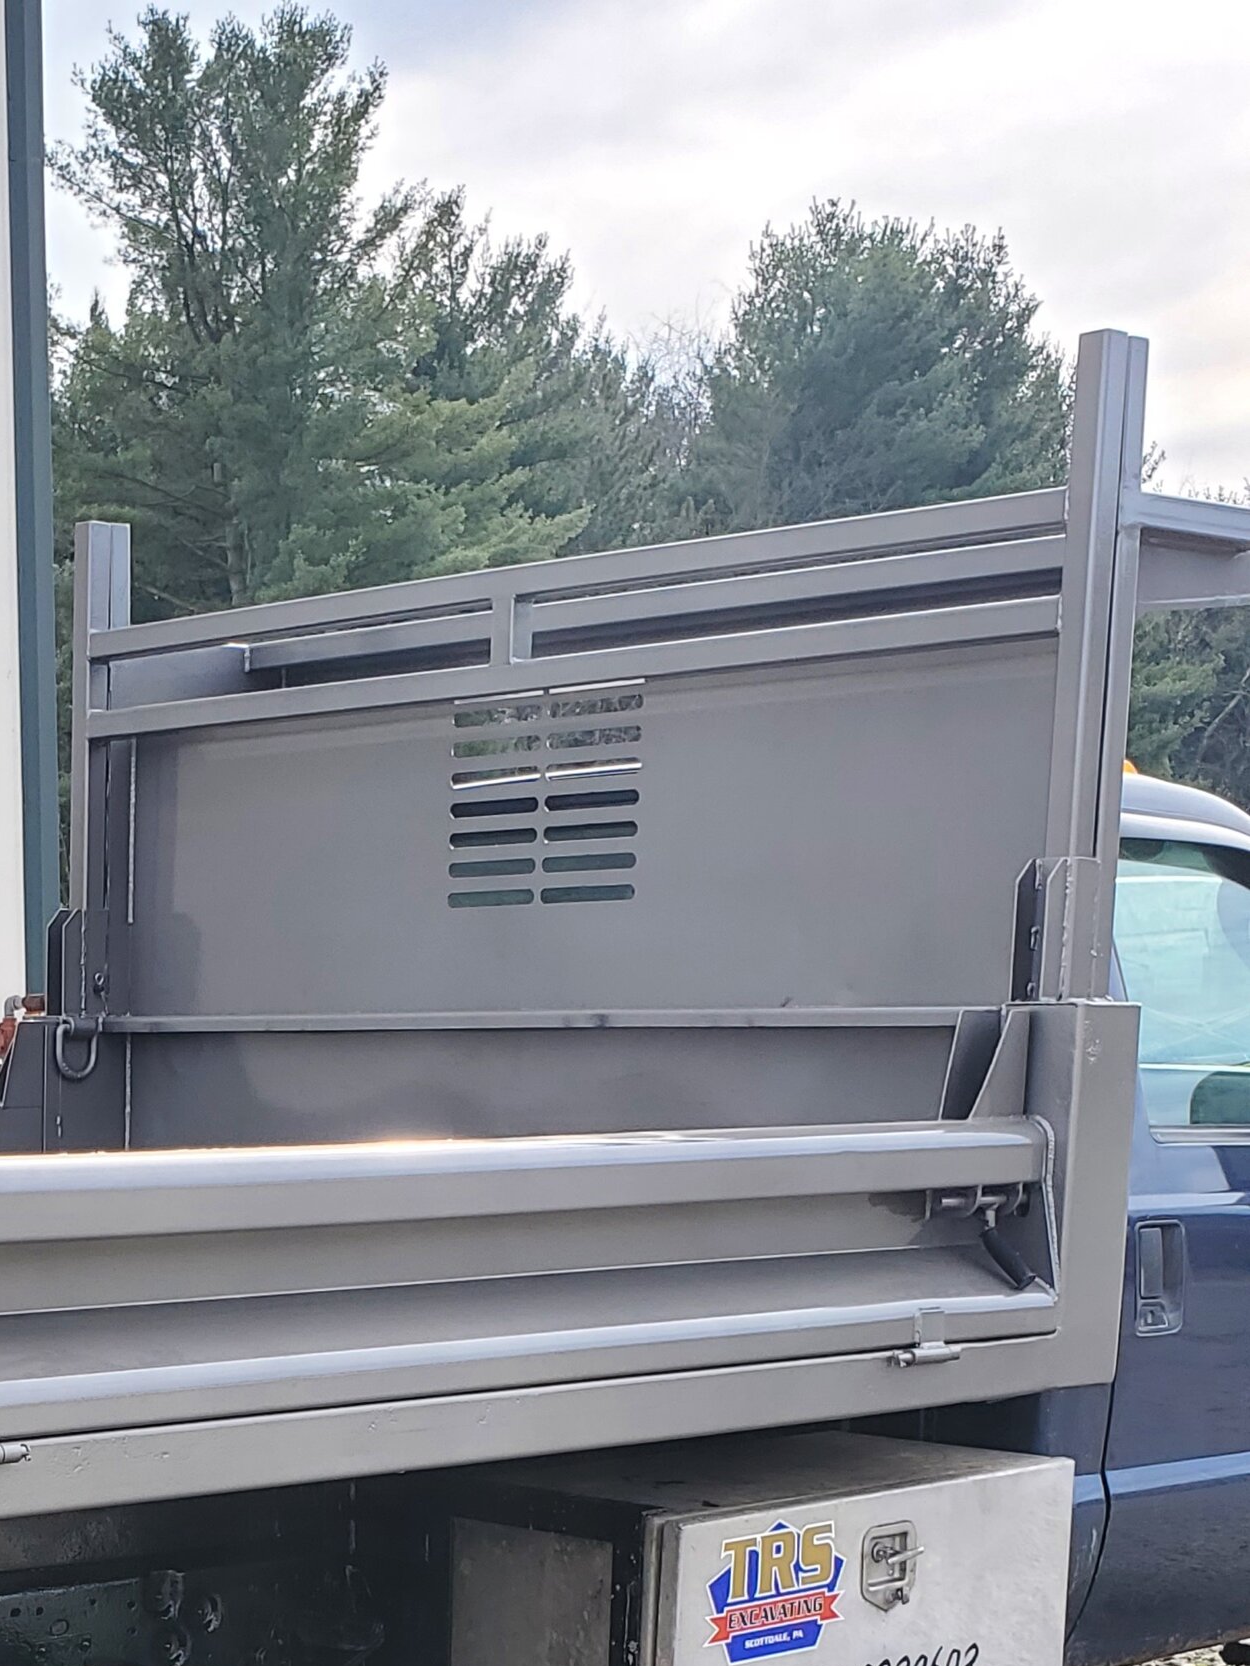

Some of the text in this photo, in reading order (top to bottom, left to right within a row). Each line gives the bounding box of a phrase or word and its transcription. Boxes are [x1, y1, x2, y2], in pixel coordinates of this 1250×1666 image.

[722, 1521, 834, 1602] TRS
[727, 1596, 824, 1630] EXCAVATING
[744, 1629, 804, 1650] SCOTTDALE, PA
